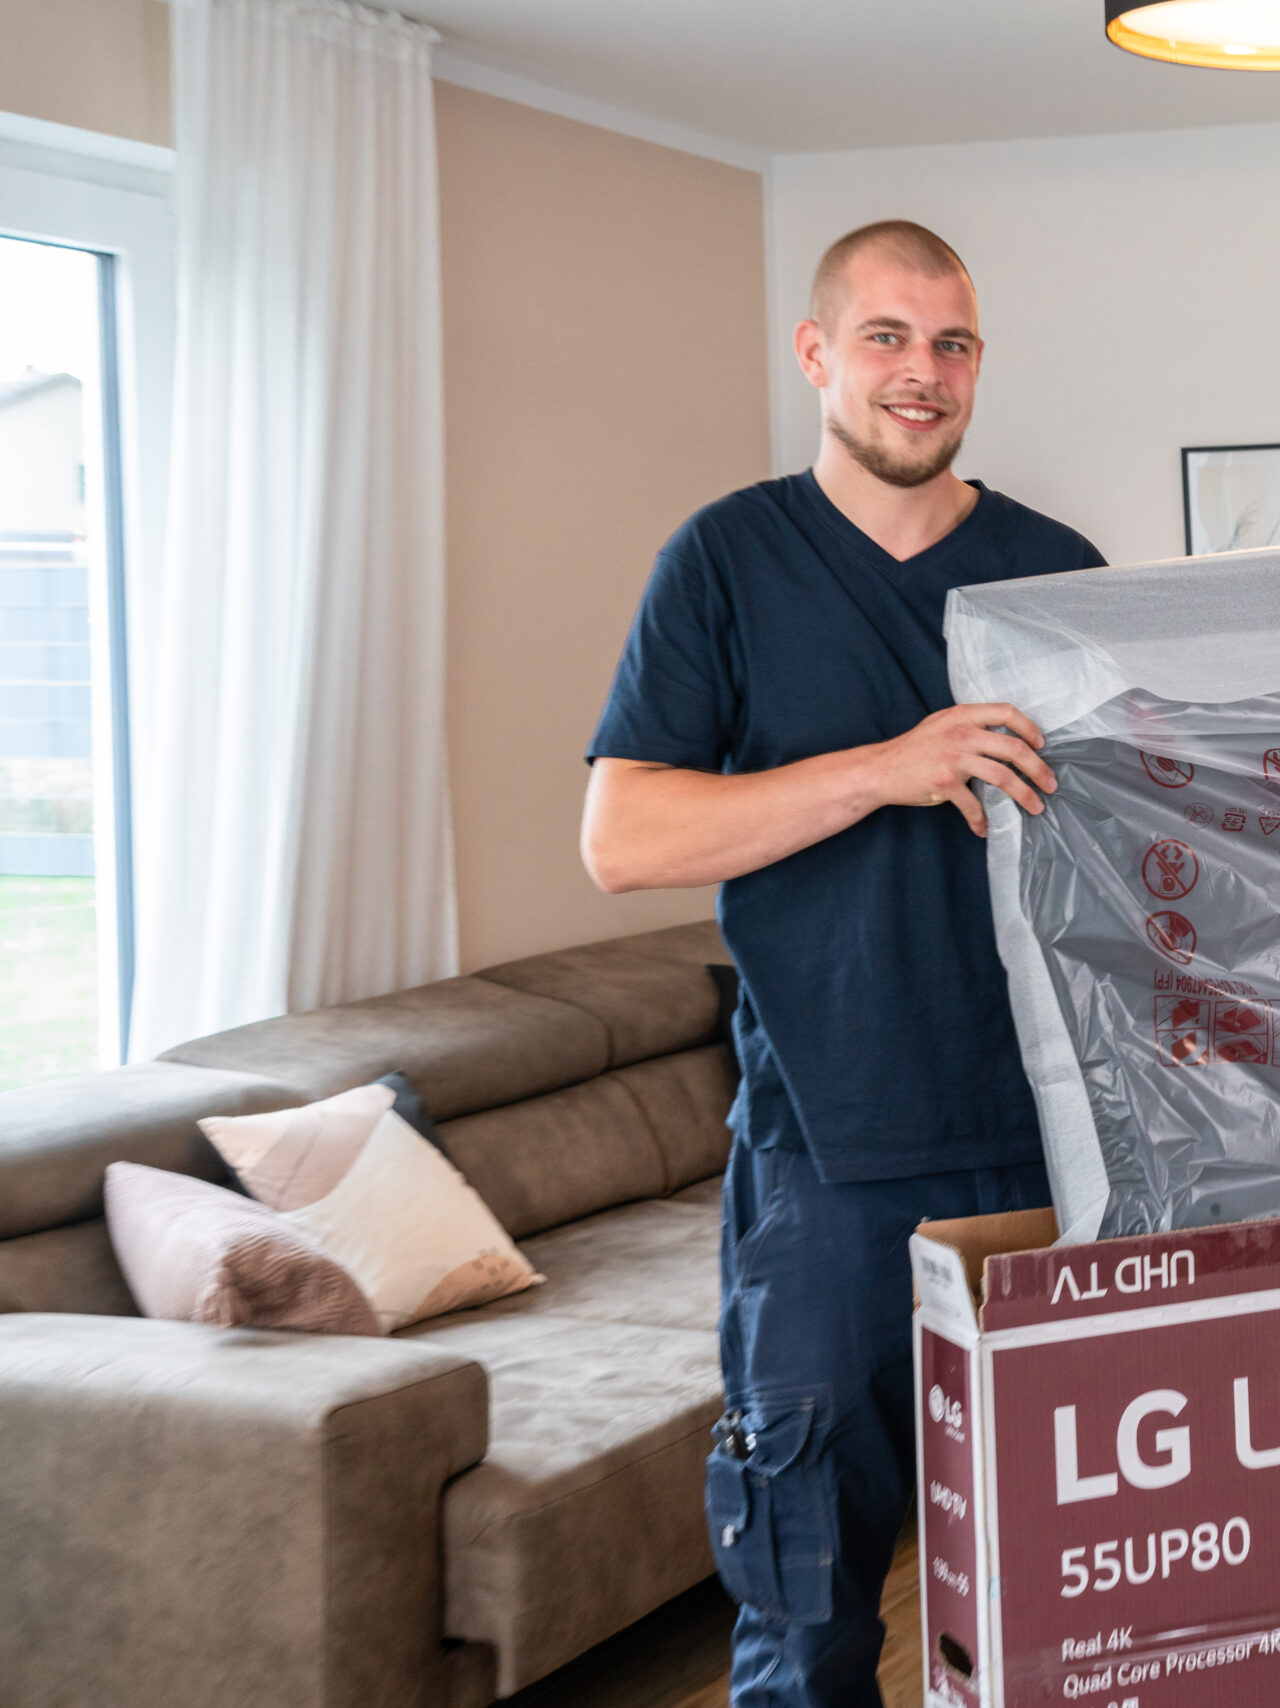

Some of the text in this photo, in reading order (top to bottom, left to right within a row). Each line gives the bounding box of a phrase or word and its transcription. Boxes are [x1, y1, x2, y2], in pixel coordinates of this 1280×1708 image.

[1050, 1249, 1195, 1305] UHD TV
[944, 1395, 963, 1428] LG
[1054, 1389, 1191, 1505] LG
[1060, 1516, 1251, 1598] 55UP80
[1061, 1625, 1134, 1663] Real 4K
[1063, 1665, 1113, 1700] Quad
[1117, 1661, 1161, 1687] Core
[1165, 1639, 1254, 1677] Processor
